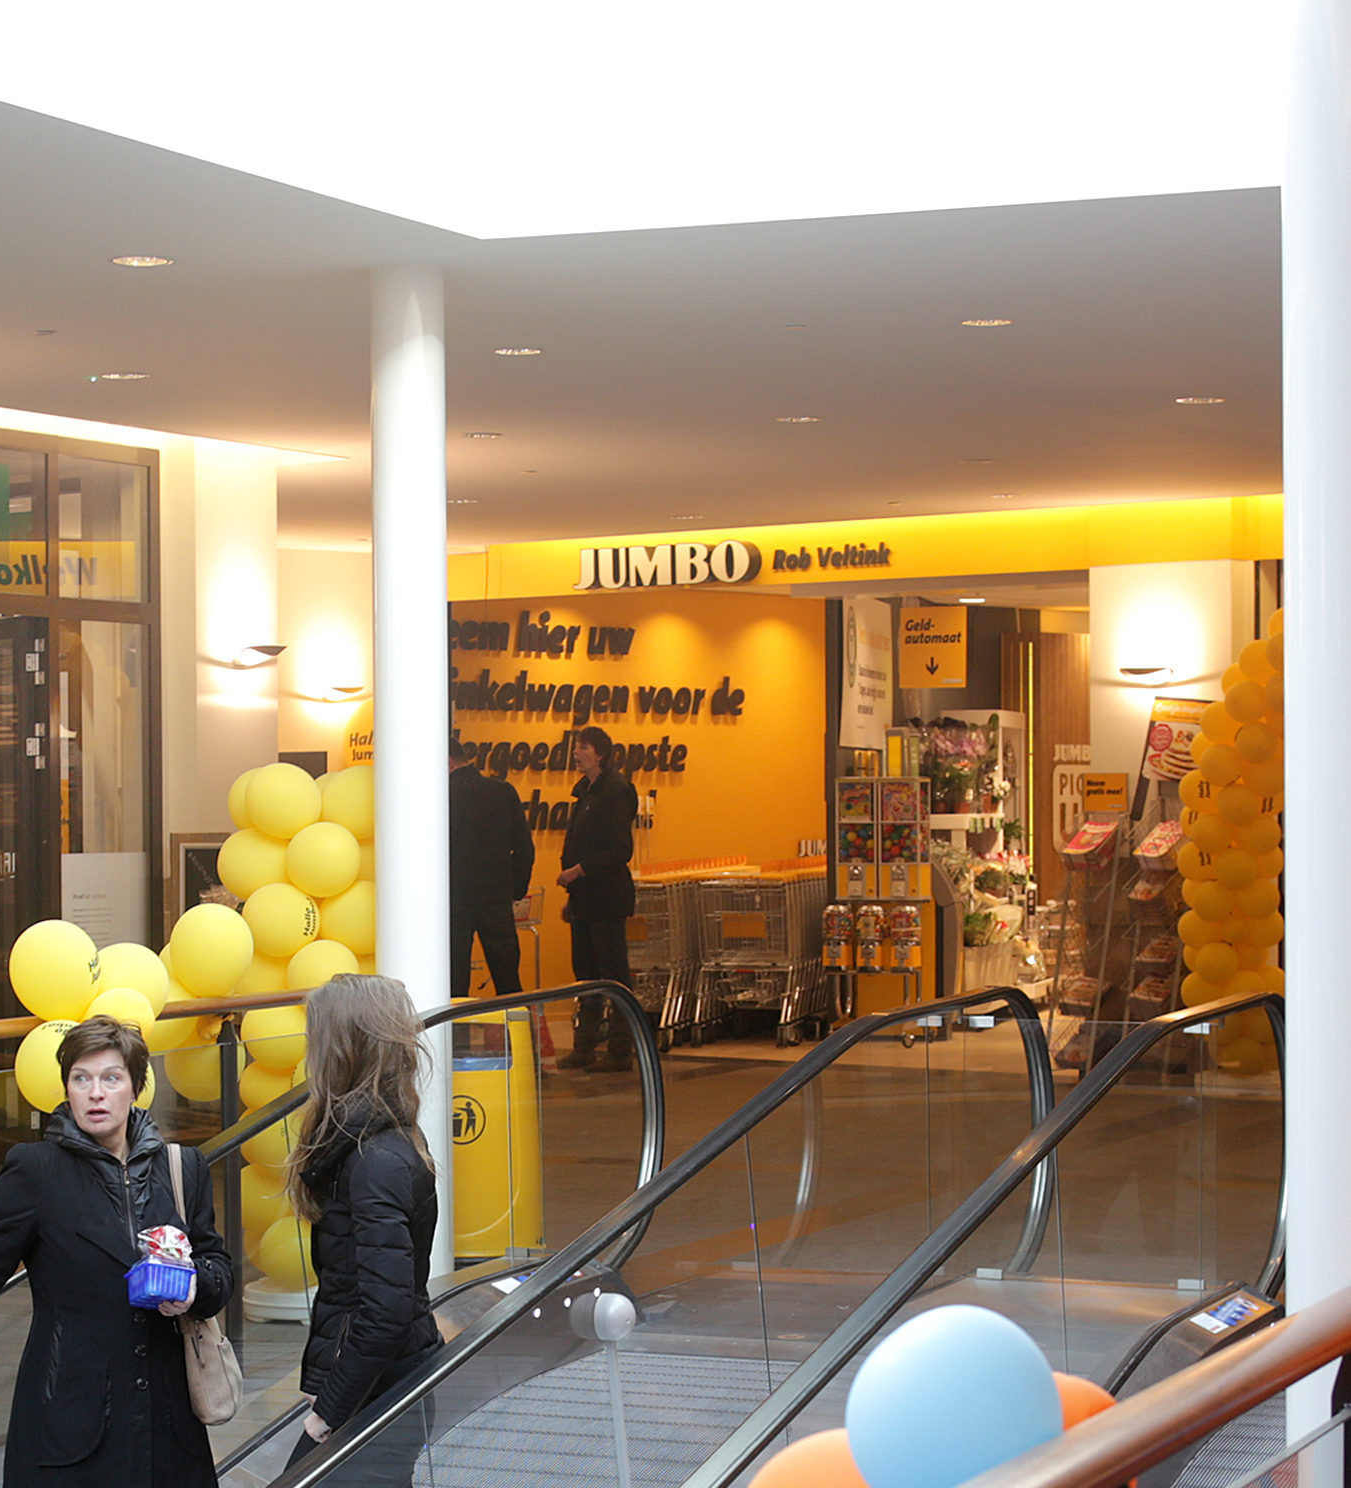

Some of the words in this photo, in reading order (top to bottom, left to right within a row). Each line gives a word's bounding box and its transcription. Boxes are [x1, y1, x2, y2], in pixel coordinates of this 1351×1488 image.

[573, 540, 753, 590] JUMBO
[773, 547, 811, 571] Rob
[817, 542, 892, 569] Veltink
[517, 610, 581, 655] hier
[587, 626, 635, 656] uw
[905, 618, 935, 631] Geld-
[904, 632, 962, 645] automaat
[449, 667, 630, 726] inkelwagen
[637, 685, 707, 716] voor
[710, 676, 745, 716] de
[1052, 744, 1091, 762] JUMB
[798, 839, 827, 857] JUM
